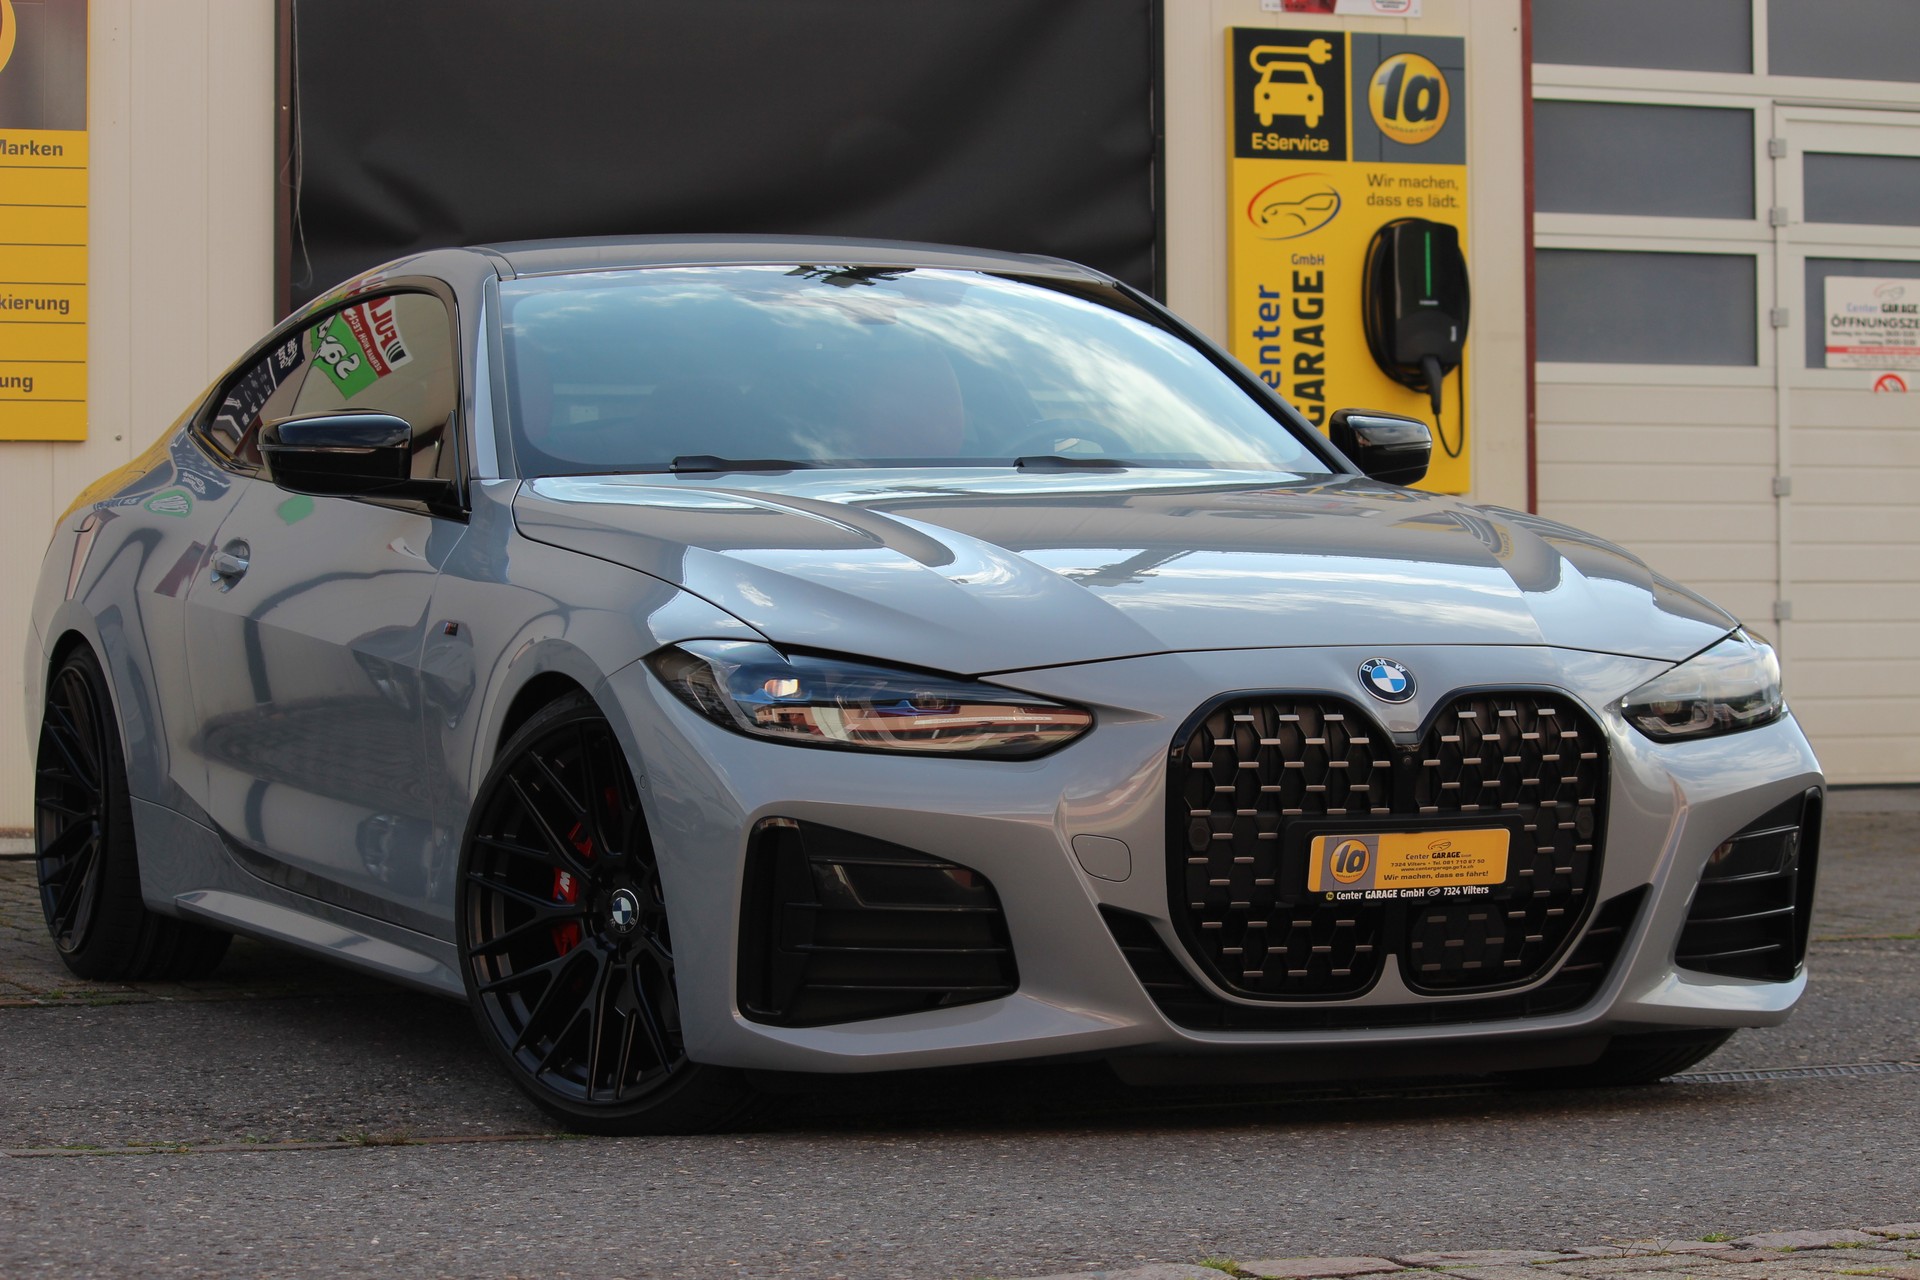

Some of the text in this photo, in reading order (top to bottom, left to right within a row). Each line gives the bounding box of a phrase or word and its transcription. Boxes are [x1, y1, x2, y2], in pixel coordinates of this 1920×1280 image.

[1252, 132, 1330, 152] E-Service
[1366, 173, 1459, 191] Wir machen,
[1366, 192, 1402, 207] dass
[1406, 196, 1424, 208] es
[1291, 253, 1325, 266] GmbH
[1881, 303, 1918, 314] GARAGE
[1252, 284, 1281, 395] enter
[1292, 270, 1326, 427] GARAGE
[1362, 659, 1406, 673] BMW
[1432, 851, 1461, 859] GARAGE
[1401, 872, 1433, 880] machen,
[1336, 891, 1363, 900] Center
[1365, 889, 1398, 899] GARAGE
[1400, 888, 1425, 898] GmbH
[1443, 886, 1461, 896] 7324
[1462, 885, 1489, 895] Vilters
